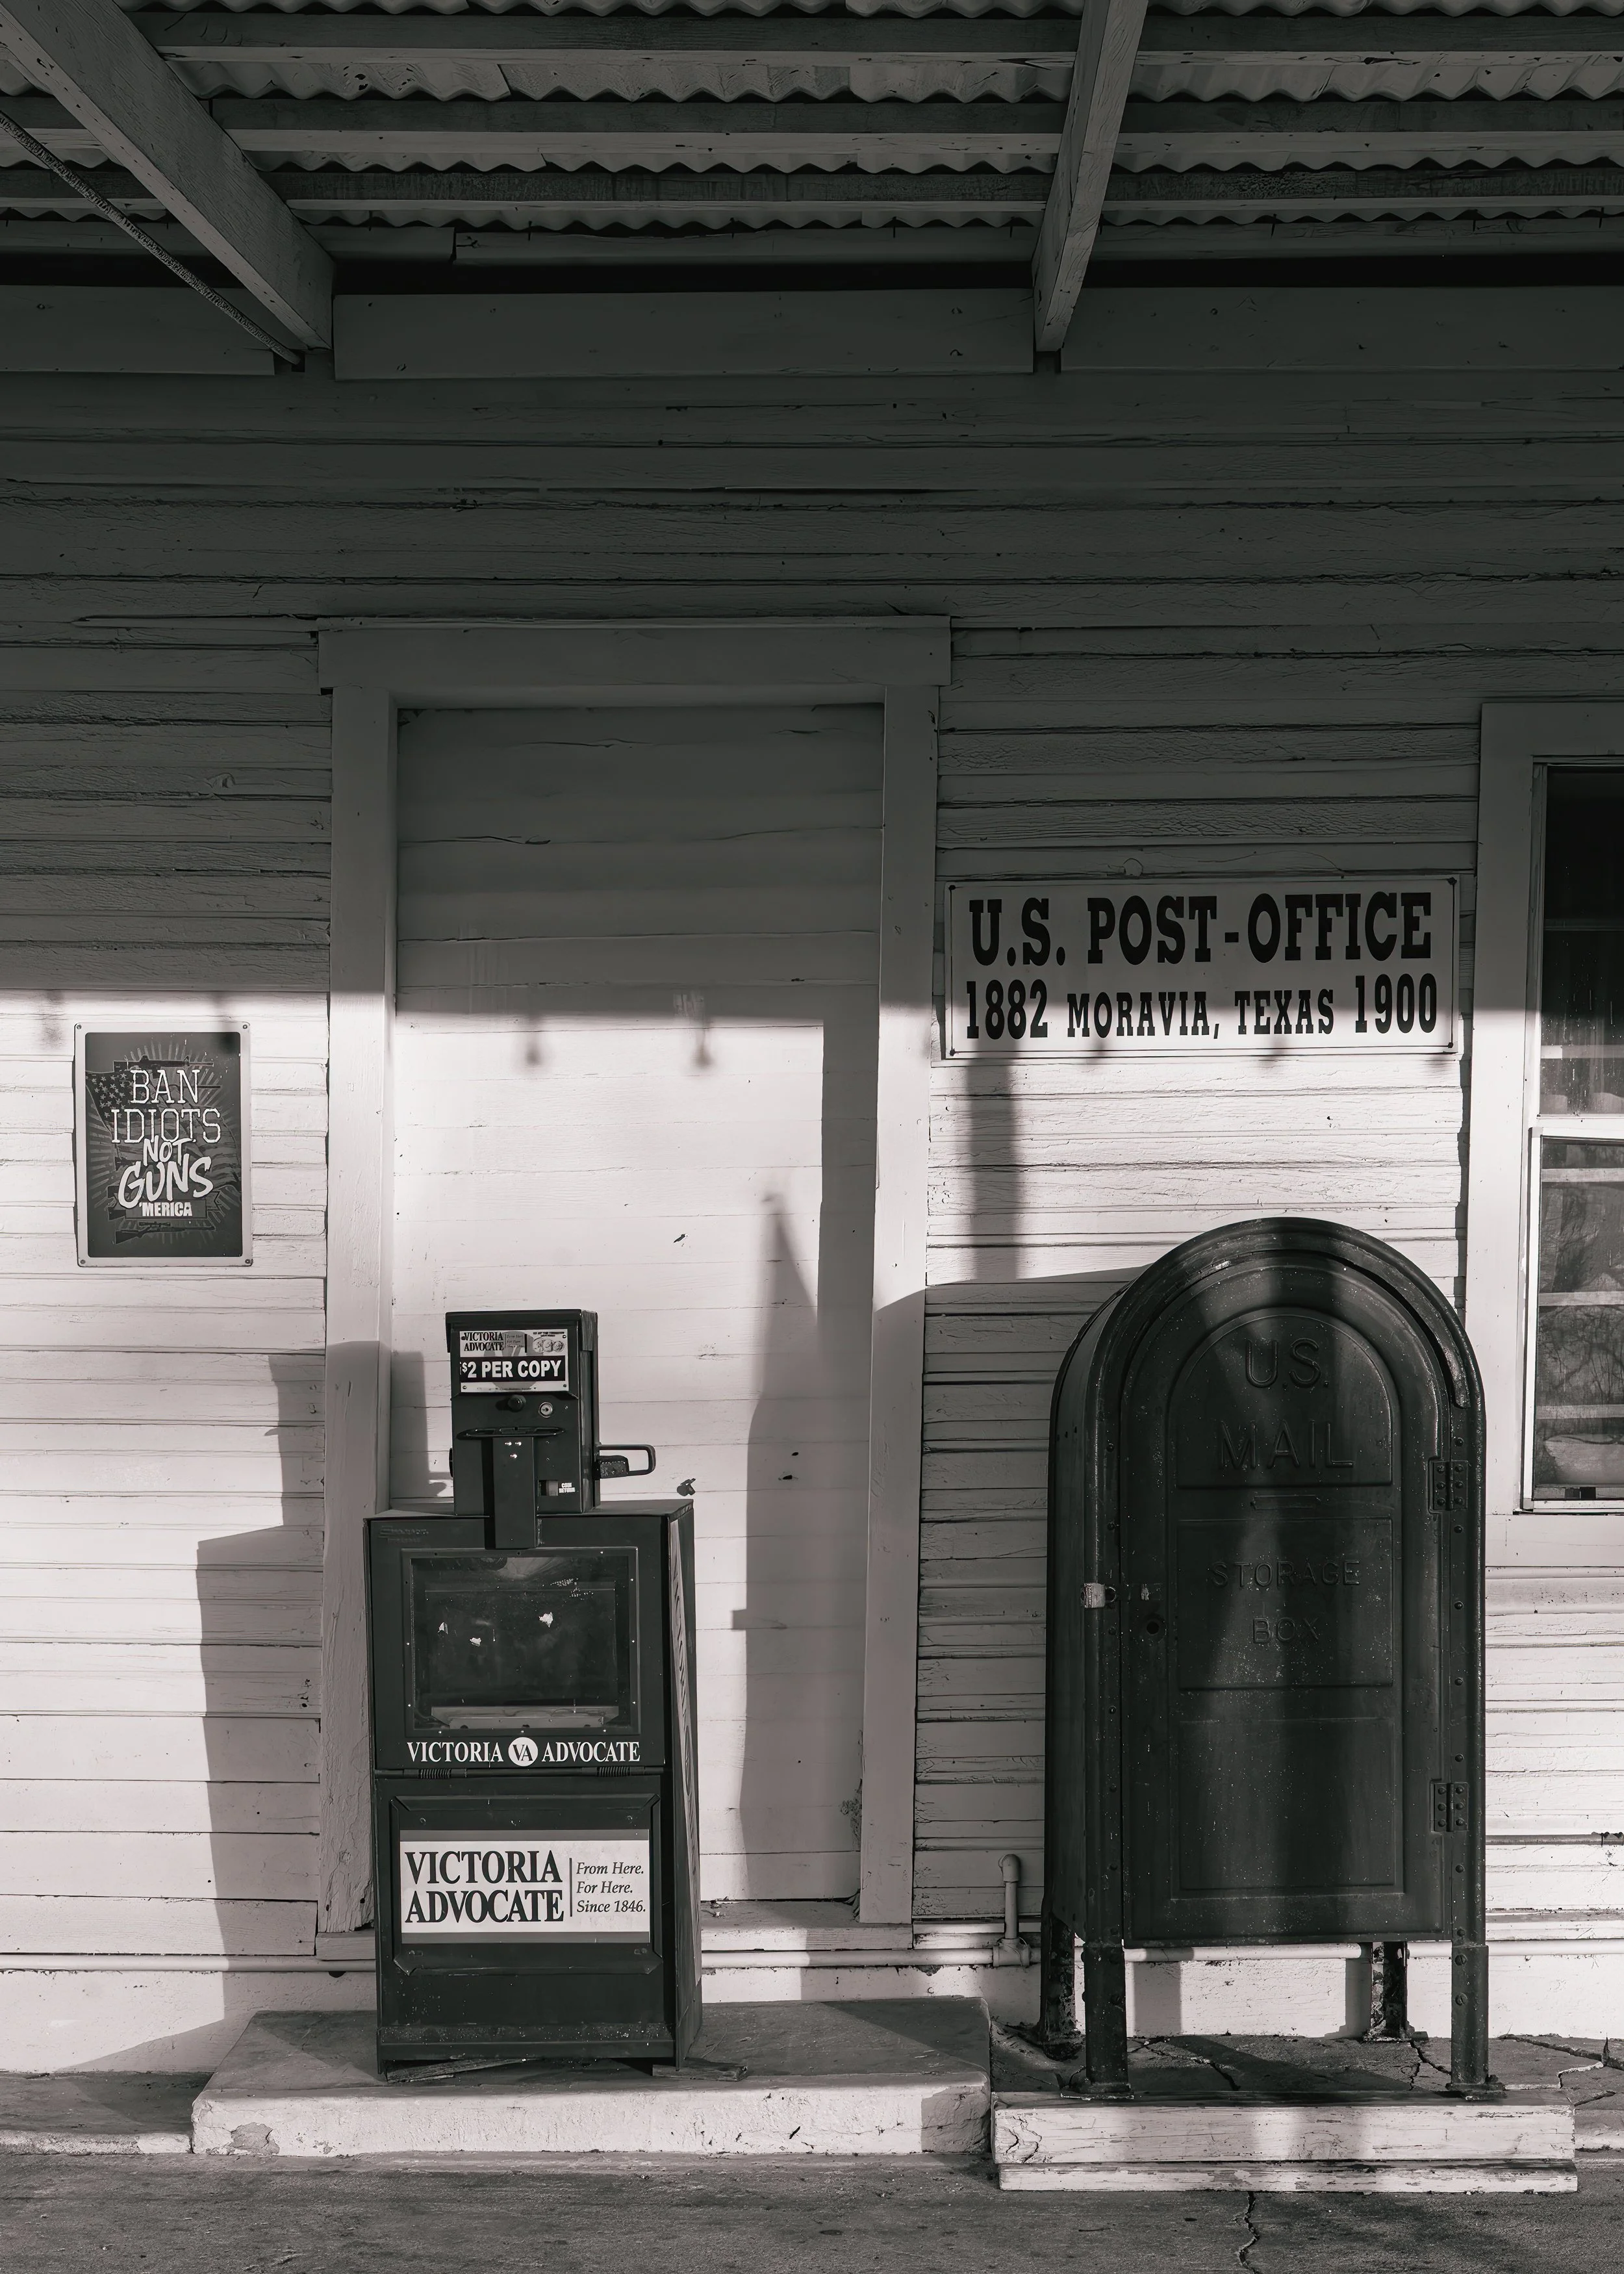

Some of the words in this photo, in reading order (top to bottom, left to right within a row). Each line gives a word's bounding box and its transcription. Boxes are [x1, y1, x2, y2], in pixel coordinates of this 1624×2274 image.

[969, 897, 1066, 967] U.S.
[1087, 891, 1431, 965] POST-OFFICE
[966, 978, 1048, 1043] 1882
[1067, 991, 1219, 1040] MORAVIA,
[1234, 988, 1334, 1035] TEXAS
[1354, 973, 1437, 1034] 1900
[129, 1069, 201, 1104] BAN
[110, 1108, 221, 1143] IDIOTS
[143, 1135, 194, 1166] NOT
[118, 1153, 214, 1209] GUNS
[138, 1201, 193, 1217] 'MERICA
[464, 1331, 503, 1341] VICTORIA
[464, 1342, 504, 1351] ADVOCATE
[462, 1361, 477, 1378] $2
[481, 1361, 513, 1378] PER
[517, 1360, 562, 1377] COPY
[1245, 1337, 1329, 1388] U.S.
[1219, 1420, 1355, 1470] MAIL
[1210, 1559, 1362, 1588] STORAGE
[1252, 1616, 1321, 1645] BOX
[407, 1741, 504, 1762] VICTORIA
[512, 1744, 533, 1762] VA
[542, 1741, 641, 1762] ADVOCATE
[404, 1850, 563, 1885] VICTORIA
[576, 1862, 608, 1874] From
[612, 1861, 644, 1874] Here.
[576, 1881, 598, 1894] For
[601, 1881, 633, 1893] Here.
[405, 1889, 565, 1923] ADVOCATE
[576, 1900, 611, 1913] Since
[614, 1900, 646, 1913] 1846.
